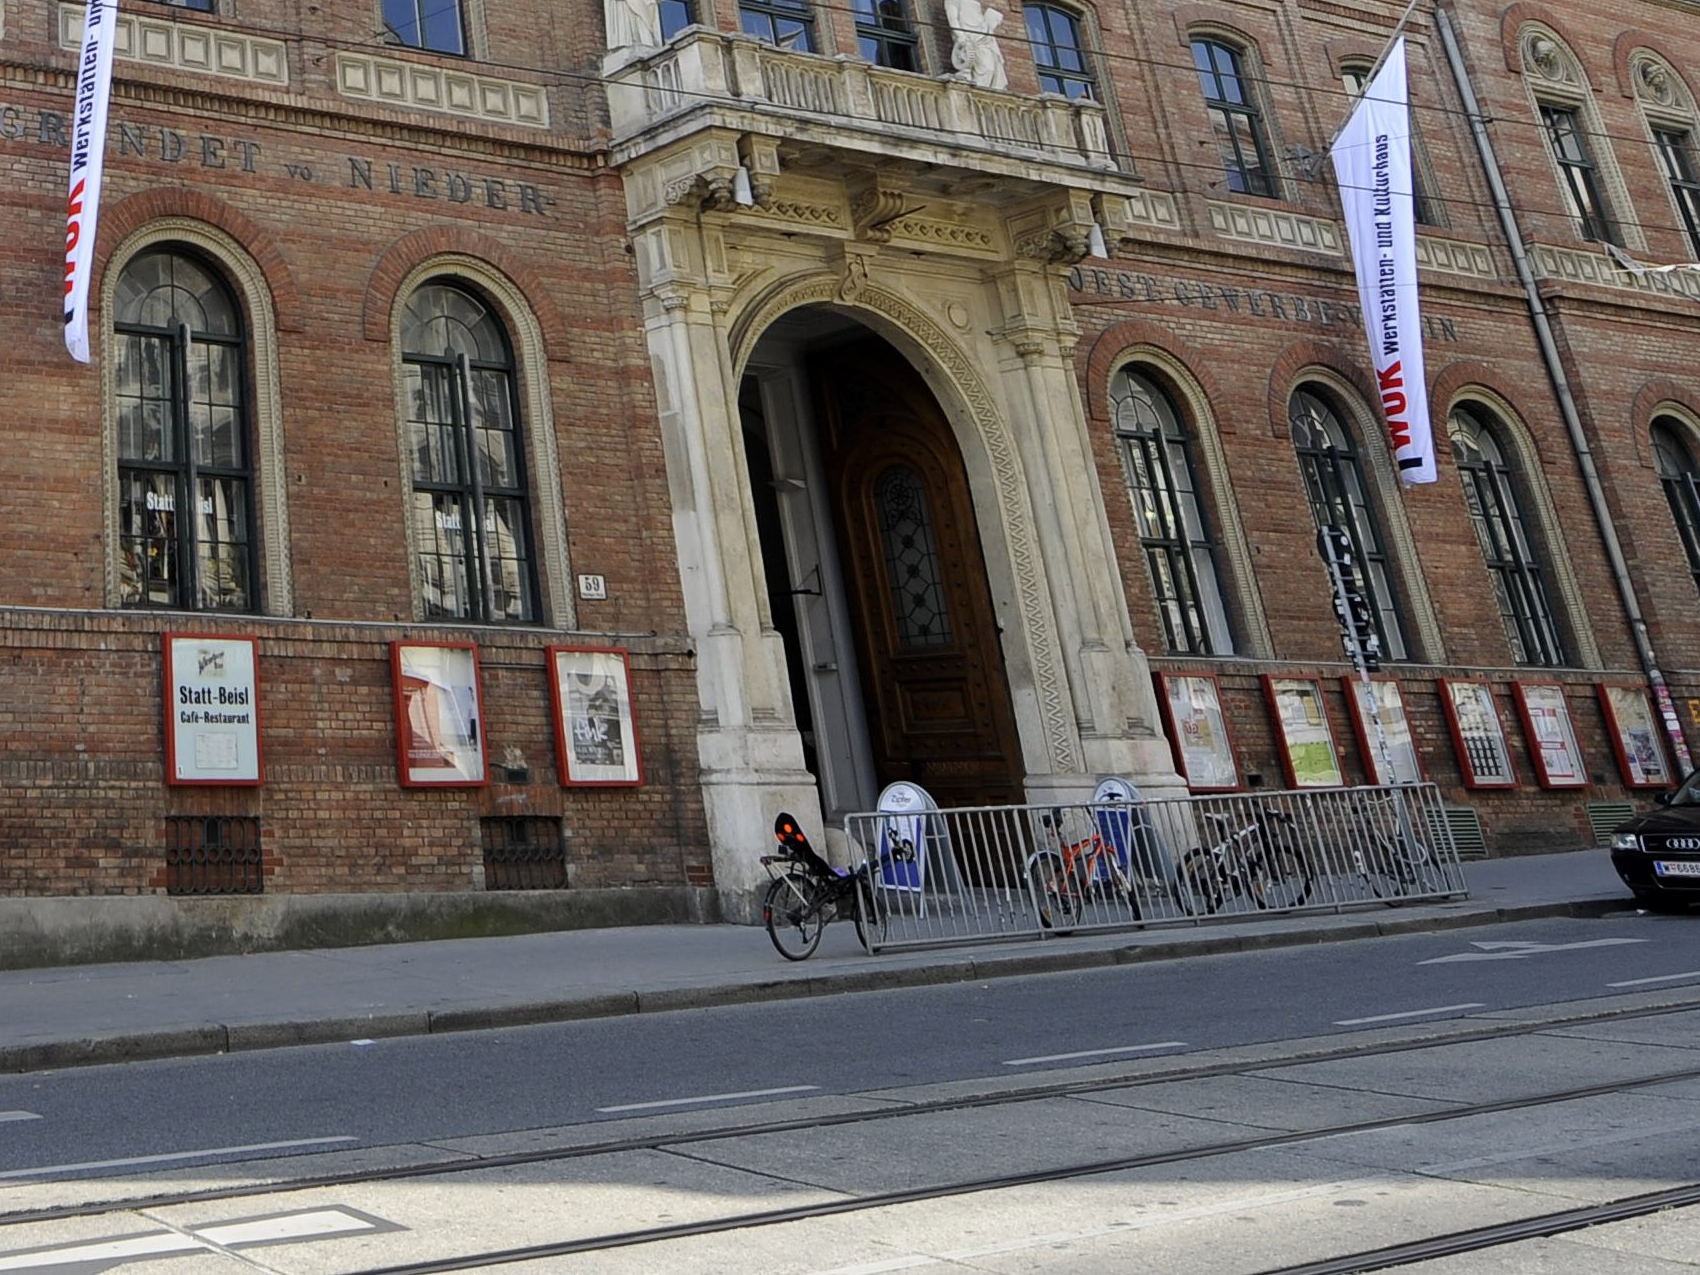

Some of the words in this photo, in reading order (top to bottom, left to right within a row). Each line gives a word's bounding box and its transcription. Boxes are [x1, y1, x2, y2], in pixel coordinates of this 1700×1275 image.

[1372, 134, 1391, 217] Kulturhaus
[1375, 222, 1393, 248] und
[1174, 280, 1458, 342] GEWERBE-VIN
[147, 491, 175, 511] Statt
[585, 576, 600, 592] 59
[179, 685, 249, 705] Statt-Beisl
